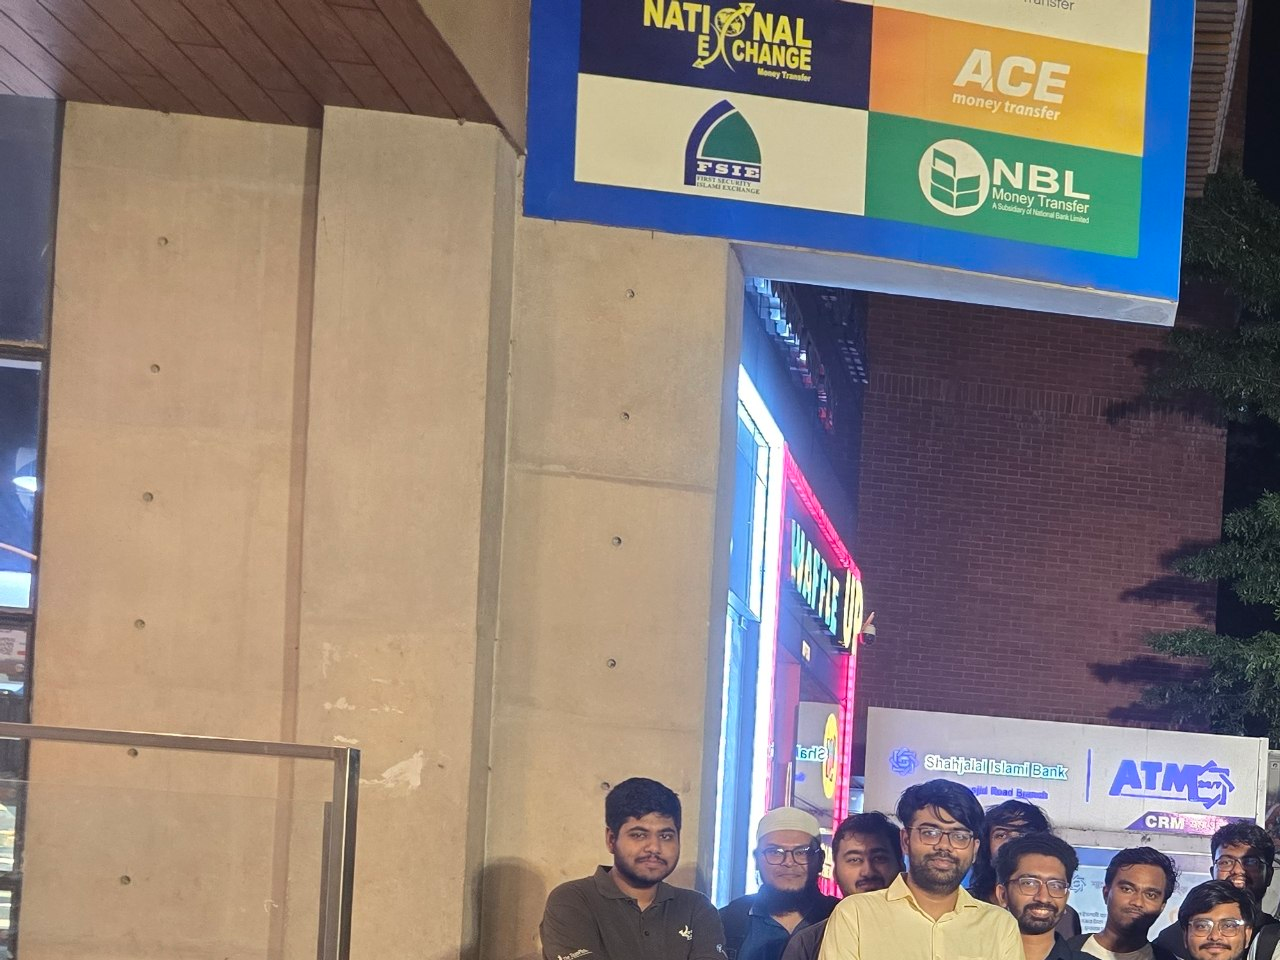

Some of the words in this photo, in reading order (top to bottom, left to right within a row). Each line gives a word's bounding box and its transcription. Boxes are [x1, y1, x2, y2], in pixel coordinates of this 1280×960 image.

[757, 67, 781, 80] Money
[781, 71, 812, 82] Transfer
[953, 48, 1071, 104] ACE
[952, 92, 1002, 114] money
[1004, 100, 1061, 121] transfer
[697, 161, 760, 179] FSIE
[992, 158, 1090, 200] NBL
[697, 182, 721, 190] ISLAMI
[722, 184, 761, 195] EXCHANGE
[717, 177, 752, 188] SECURITY
[992, 187, 1035, 208] Money
[1037, 194, 1090, 214] Transfer
[998, 203, 1026, 215] Subsidiary
[1033, 208, 1055, 219] National
[1055, 213, 1070, 221] Bank
[1070, 215, 1090, 224] Limited
[790, 518, 840, 637] WAFFLE
[843, 568, 864, 656] UP
[926, 755, 988, 775] Shahjalal
[989, 759, 1029, 777] Islami
[1031, 763, 1067, 780] Bank
[990, 787, 1014, 797] Road
[1109, 760, 1200, 801] ATM
[1145, 815, 1185, 830] CRM
